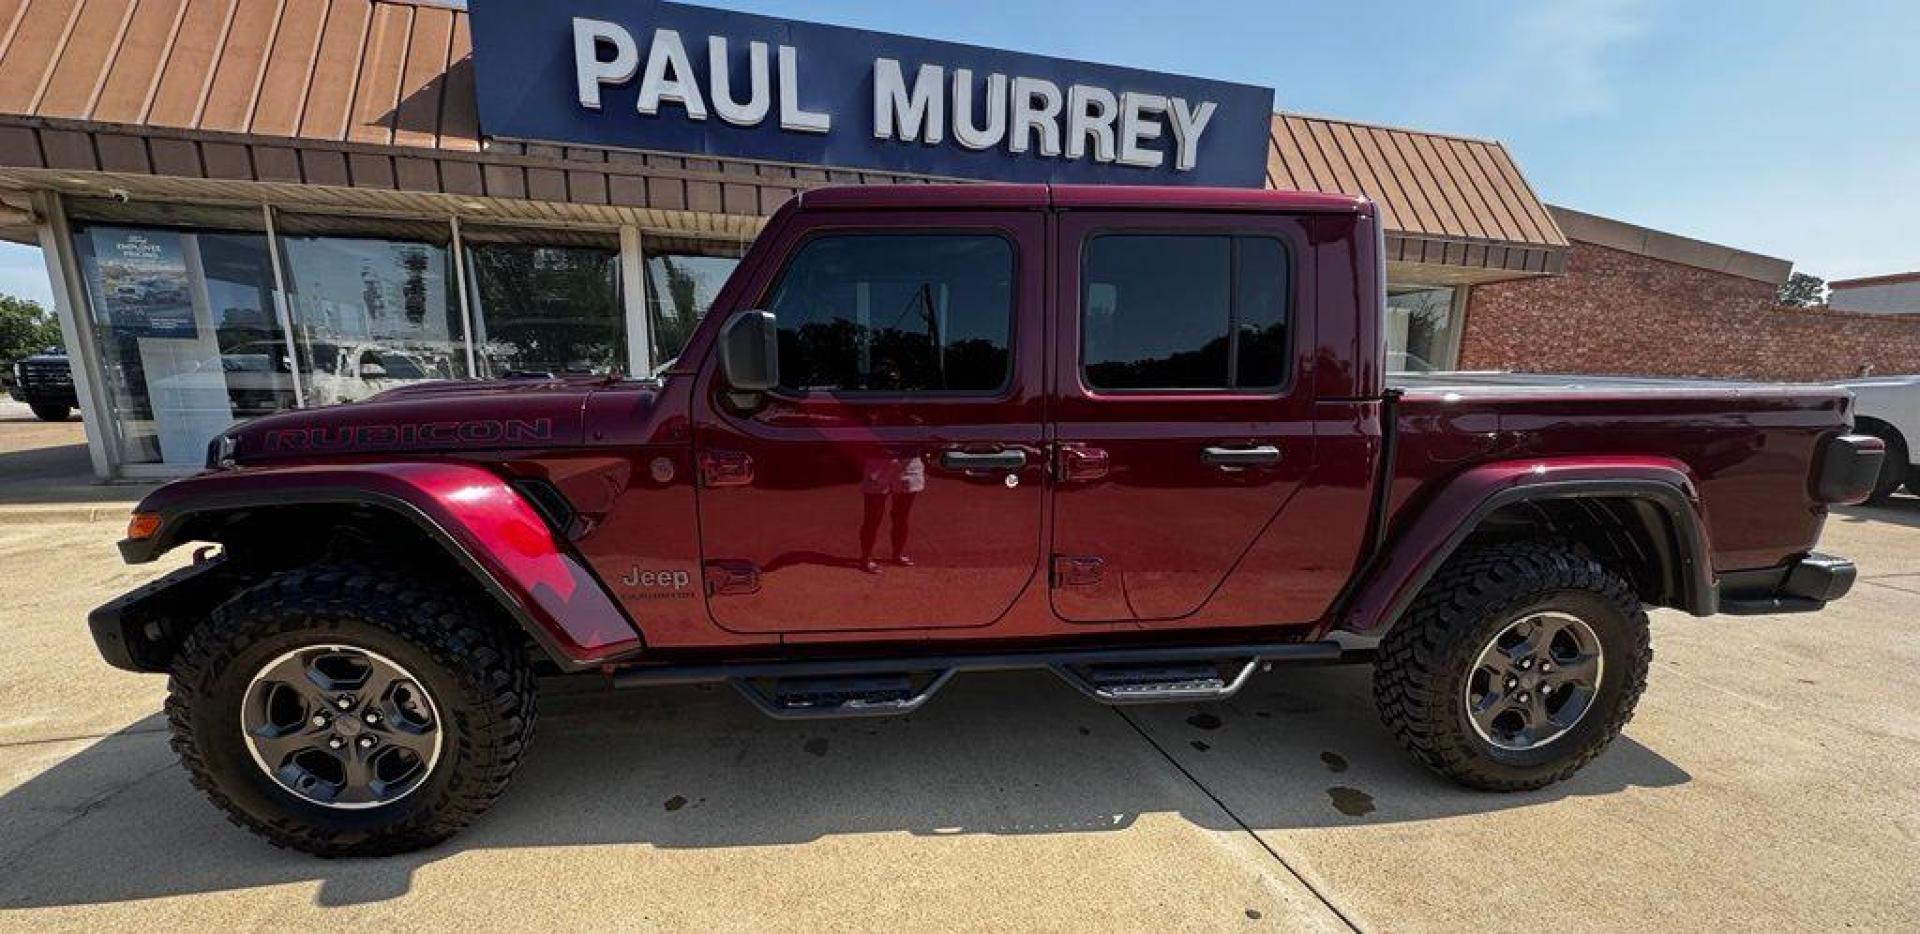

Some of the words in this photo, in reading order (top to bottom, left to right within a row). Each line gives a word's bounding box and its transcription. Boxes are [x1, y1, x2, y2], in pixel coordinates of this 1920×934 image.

[572, 17, 832, 133] PAUL
[873, 57, 1218, 171] MURREY
[264, 418, 552, 450] RUBICON
[621, 565, 690, 590] Jeep
